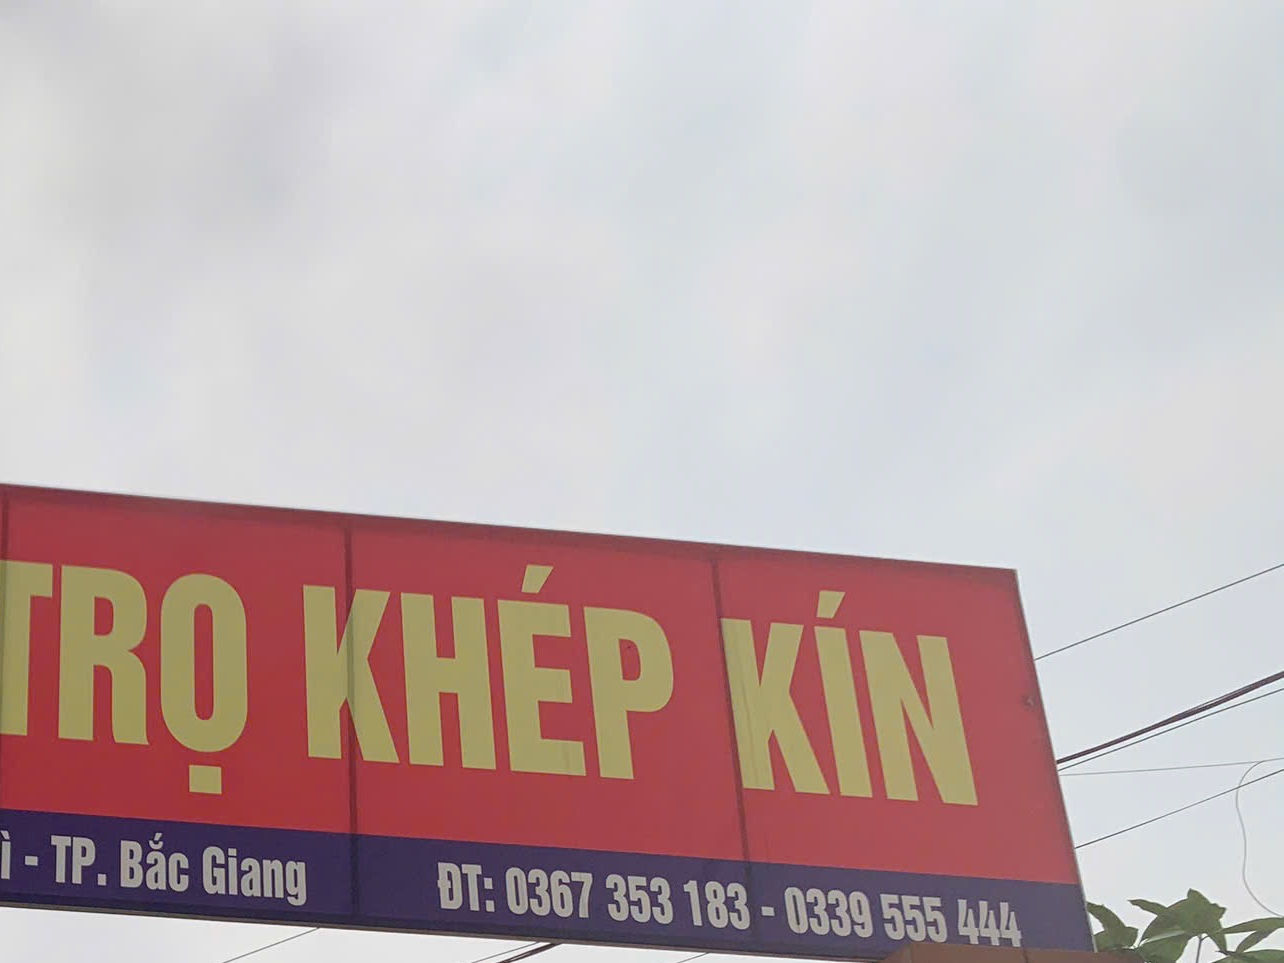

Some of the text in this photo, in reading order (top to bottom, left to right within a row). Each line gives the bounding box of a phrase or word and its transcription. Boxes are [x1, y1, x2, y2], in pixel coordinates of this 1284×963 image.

[302, 564, 674, 780] KHÉP
[721, 591, 978, 806] KÍN
[24, 855, 39, 867] -
[50, 834, 107, 886] TP.
[120, 832, 189, 892] Bắc
[202, 846, 308, 906] Giang
[437, 861, 1024, 948] ĐT: 0367 353 183 - 0339 555 444
